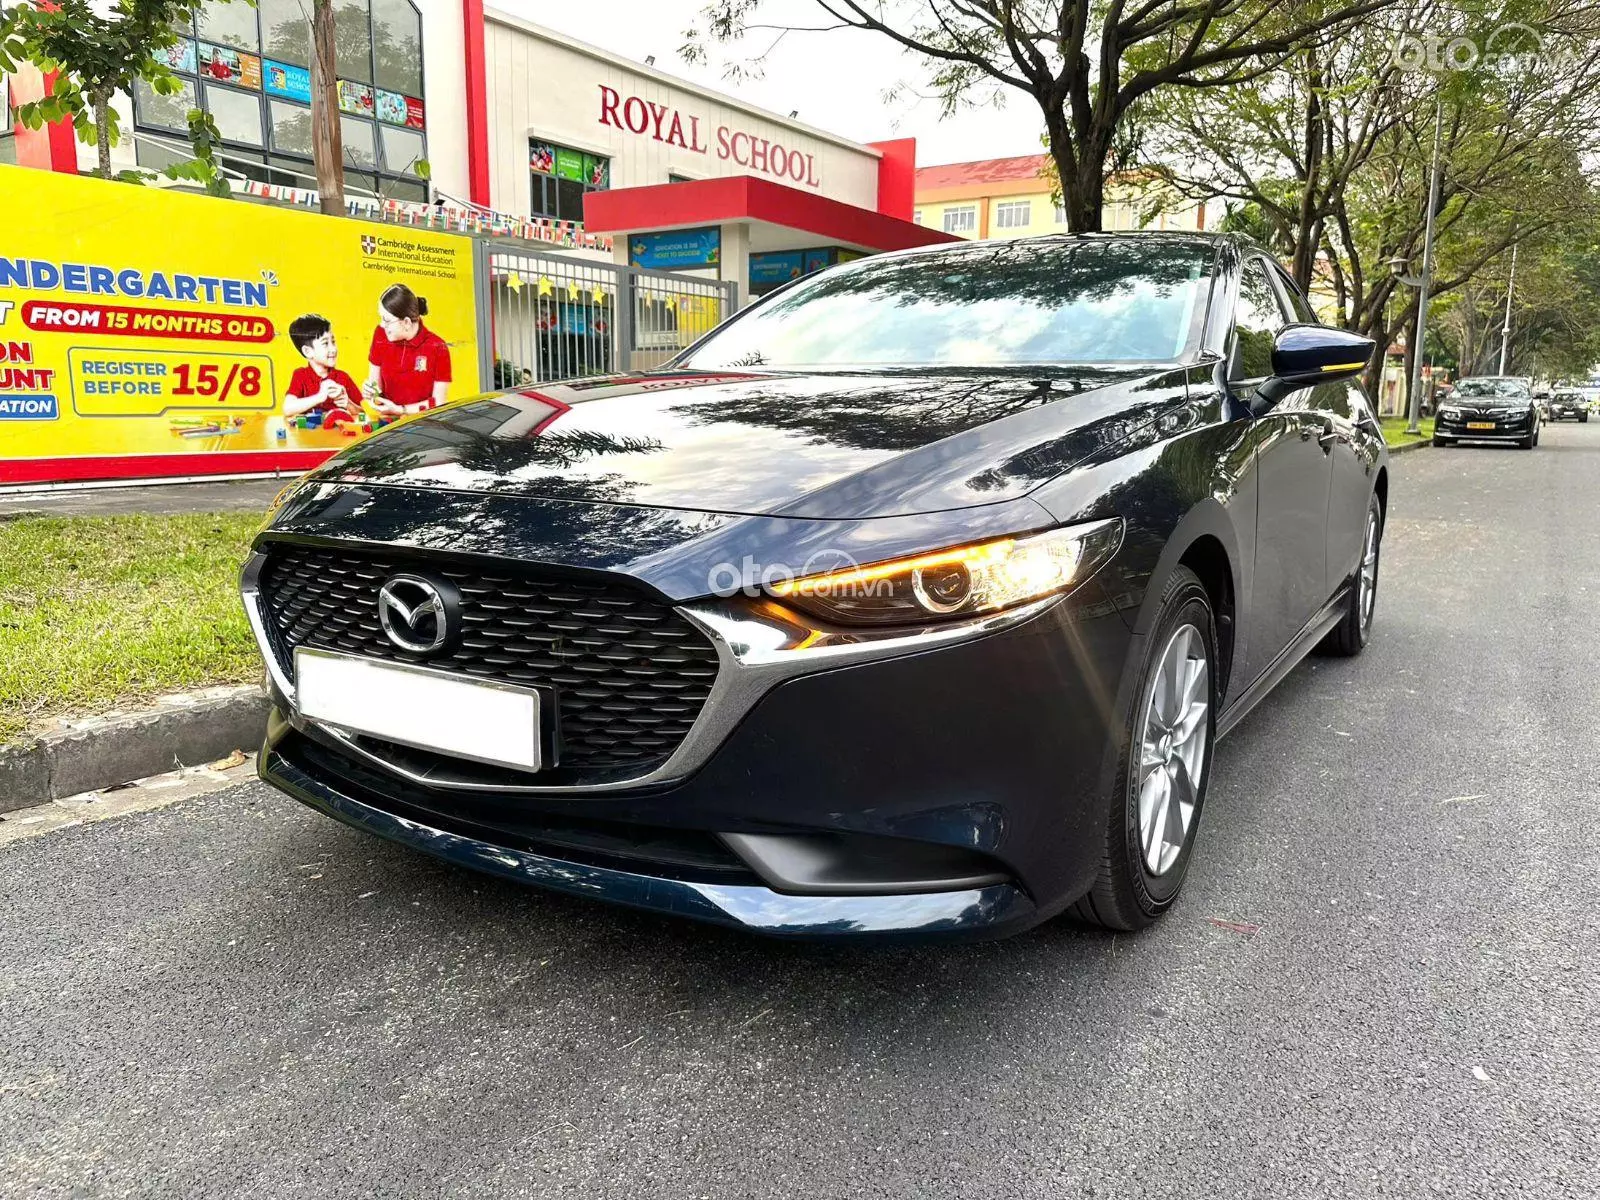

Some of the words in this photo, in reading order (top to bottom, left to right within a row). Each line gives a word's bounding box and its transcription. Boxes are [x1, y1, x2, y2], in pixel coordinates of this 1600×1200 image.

[598, 84, 708, 154] ROYAL
[717, 125, 820, 188] SCHOOL
[377, 238, 415, 252] Cambridge
[417, 243, 455, 256] Assessment
[378, 249, 420, 261] International
[422, 254, 453, 265] Education
[362, 261, 396, 273] Cambridge
[397, 266, 436, 277] International
[438, 270, 456, 279] School
[0, 258, 267, 307] NDERGARTEN
[30, 307, 100, 327] FROM
[106, 312, 128, 329] 15
[133, 314, 222, 334] MONTHS
[227, 321, 266, 337] OLD
[82, 361, 167, 376] REGISTER
[84, 381, 162, 395] BEFORE
[171, 363, 261, 402] 15/8
[0, 400, 51, 413] ATION
